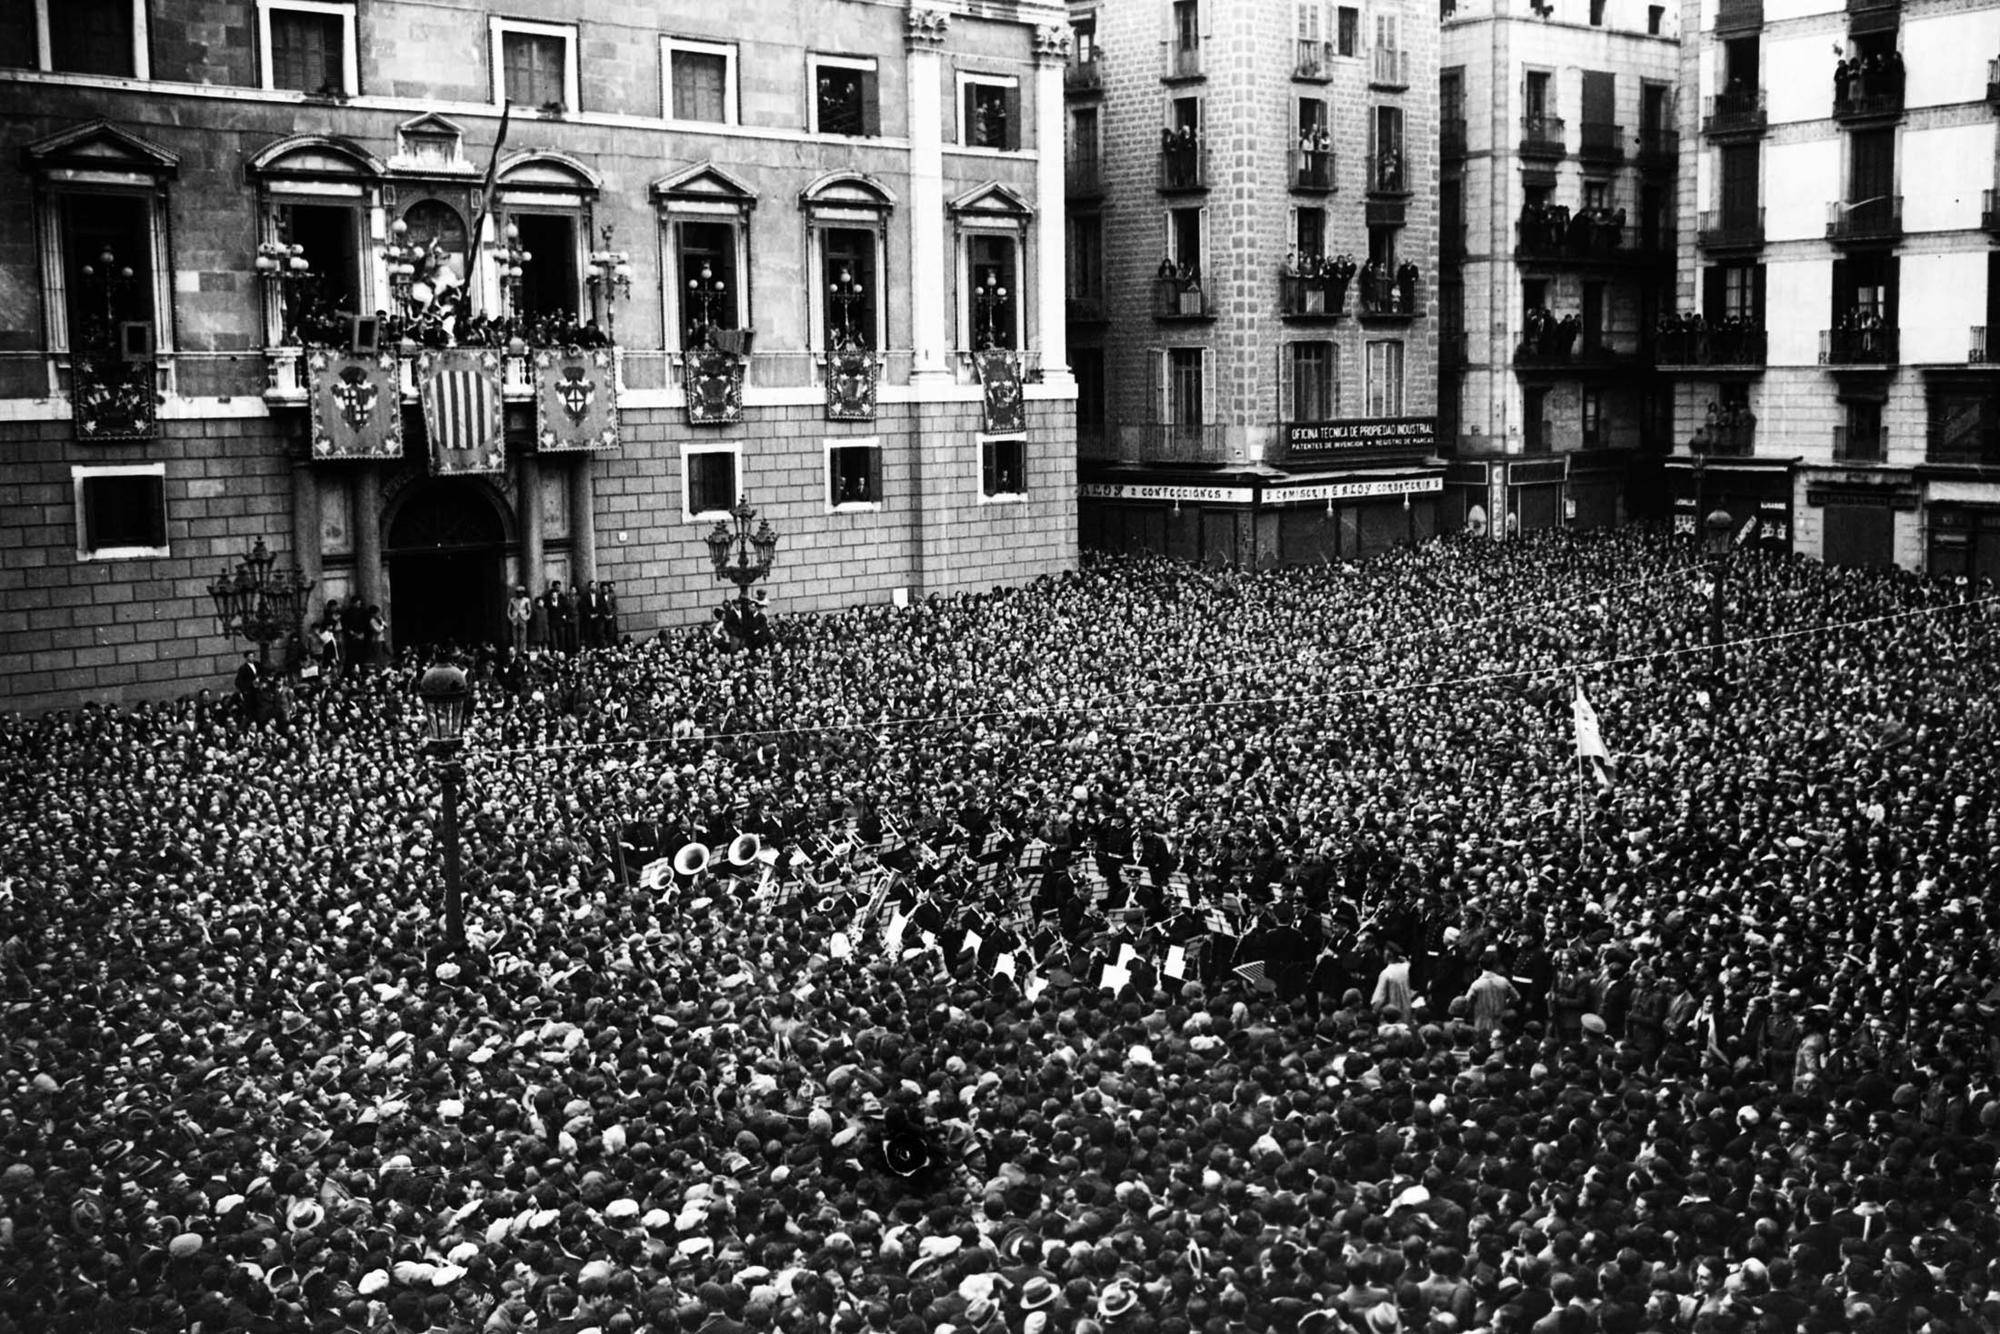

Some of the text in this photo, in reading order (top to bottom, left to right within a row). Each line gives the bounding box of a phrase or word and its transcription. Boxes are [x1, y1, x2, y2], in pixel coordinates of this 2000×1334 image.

[1291, 428, 1318, 440] OFICINA
[1349, 425, 1359, 438] DE
[1359, 424, 1396, 437] PROPIEDAD
[1397, 422, 1434, 435] INDUSTRIAL
[1291, 442, 1323, 450] PATENTES
[1324, 441, 1332, 449] DE
[1141, 487, 1221, 499] CONFECCIONES
[1276, 488, 1327, 500] CAMISERIA
